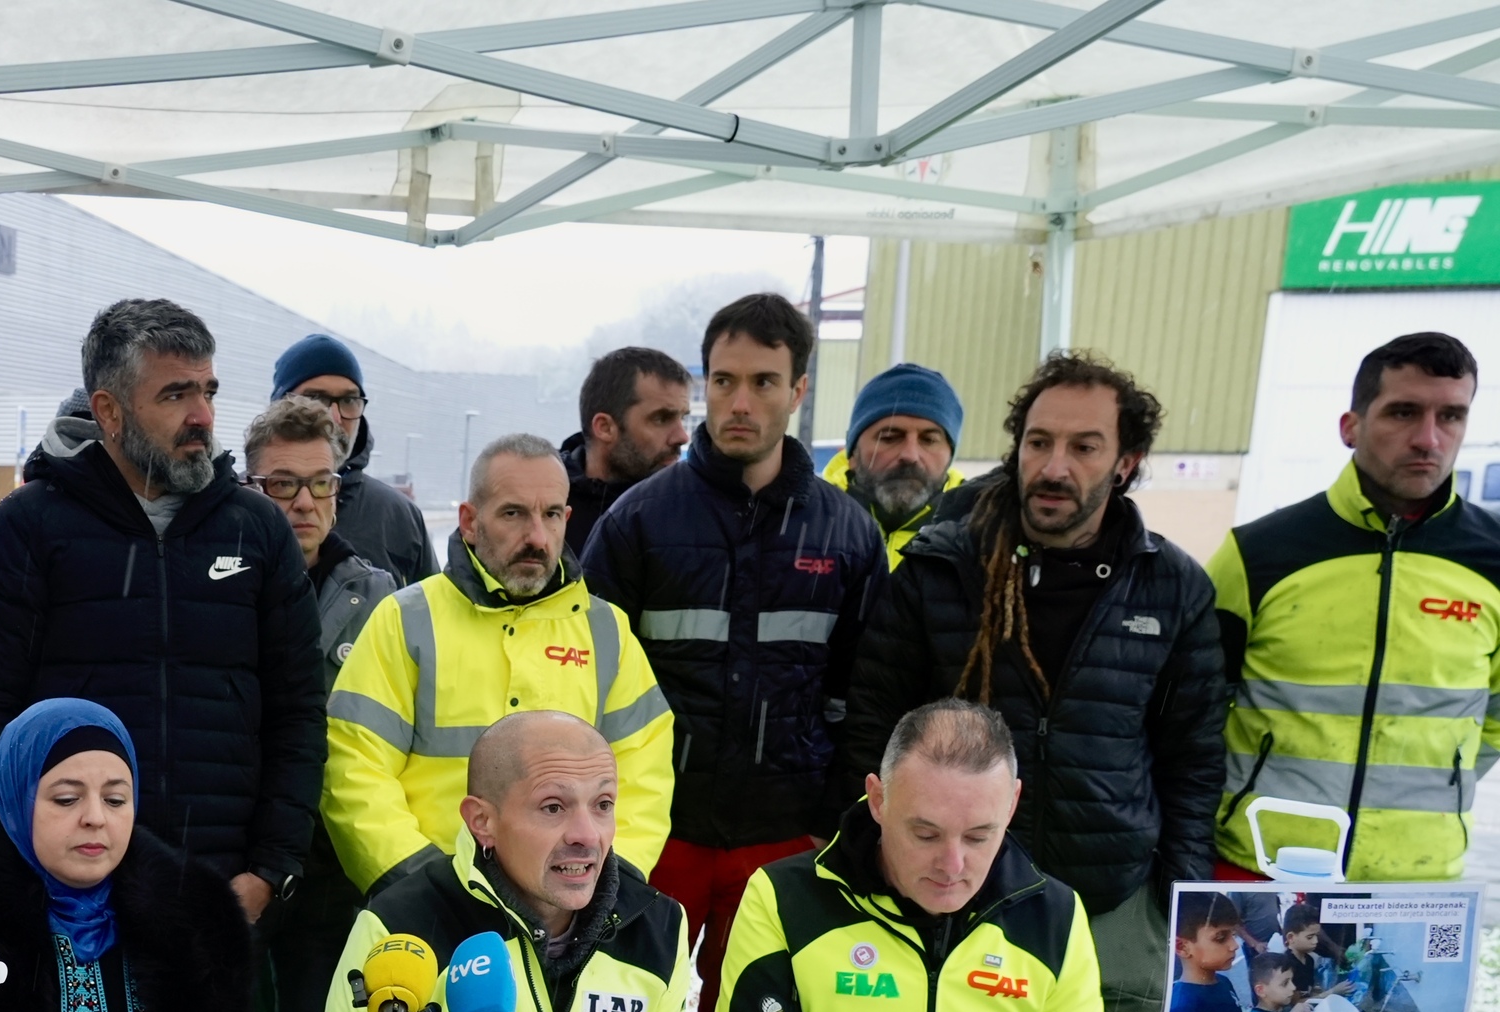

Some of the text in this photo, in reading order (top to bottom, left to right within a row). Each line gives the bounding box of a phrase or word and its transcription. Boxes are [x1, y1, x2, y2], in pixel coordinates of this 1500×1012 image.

[1322, 194, 1483, 257] HINE
[1317, 257, 1455, 273] RENOVABLES
[214, 556, 243, 570] NIKE
[794, 558, 835, 575] CAF
[1419, 597, 1482, 622] CAF
[544, 645, 590, 668] CAF
[1358, 902, 1385, 910] txartel
[1421, 901, 1467, 910] ekarpenak:
[366, 940, 426, 963] SER
[451, 955, 491, 984] tve
[835, 971, 900, 999] ELA
[967, 970, 1029, 999] CAF
